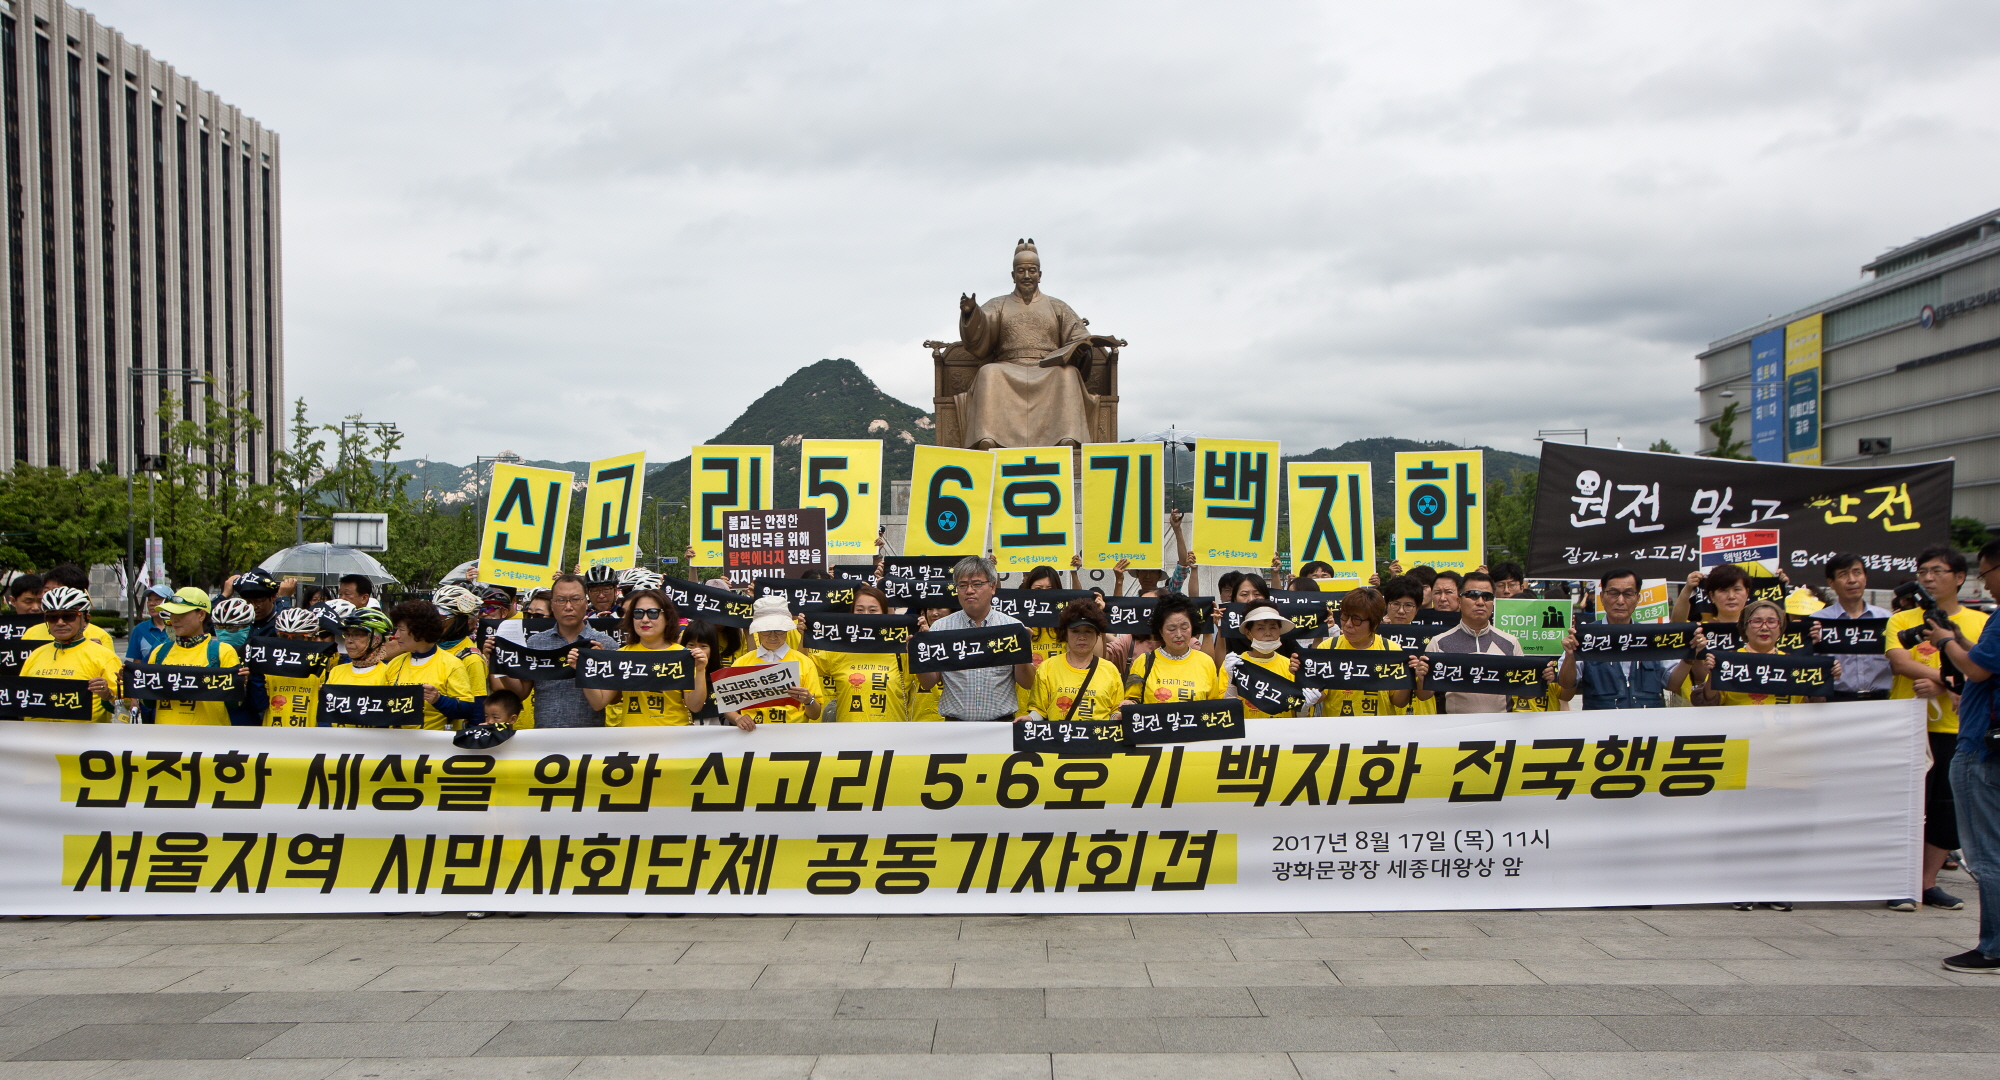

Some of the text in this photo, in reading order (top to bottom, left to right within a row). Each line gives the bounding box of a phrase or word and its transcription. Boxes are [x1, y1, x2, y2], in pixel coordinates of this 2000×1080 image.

[701, 456, 764, 542] 리
[925, 464, 974, 546] 6
[1000, 456, 1067, 548] 호
[1090, 454, 1152, 544] 기
[1204, 450, 1268, 542] 백
[1404, 460, 1477, 552] 화
[1571, 469, 1921, 536] 원전 말고 안전
[585, 463, 635, 552] 고
[493, 477, 562, 567] 신
[729, 514, 798, 531] 불교는 안전한
[1298, 474, 1364, 562] 지
[729, 531, 810, 549] 대한민국을 위해
[1712, 533, 1747, 550] 잘가라
[729, 549, 821, 566] 탈핵에너지 전환을
[1723, 549, 1761, 562] 핵발전소
[919, 566, 945, 582] 말고
[794, 589, 823, 606] 말고
[827, 588, 855, 605] 안전
[884, 580, 912, 598] 원전
[915, 581, 943, 599] 말고
[1637, 590, 1653, 603] OP!
[1754, 585, 1783, 601] 안전
[694, 594, 721, 612] 말고
[725, 601, 753, 619] 안전
[1024, 600, 1052, 617] 말고
[1110, 606, 1139, 624] 원전
[1636, 606, 1665, 620] 5,6호기
[1291, 614, 1318, 630] 안전
[1500, 615, 1537, 626] STOP!
[0, 624, 26, 640] 말고
[812, 621, 909, 643] 원전 말고 안전
[1532, 630, 1564, 641] 5,6호기
[1581, 632, 1686, 652] 원전 말고 안전
[1706, 632, 1735, 650] 원전
[1845, 628, 1877, 645] 말고
[0, 650, 17, 667] 전
[273, 649, 302, 666] 말고
[918, 635, 1022, 662] 원전 말고 안전
[525, 655, 555, 670] 말고
[585, 657, 614, 678] 원전
[619, 661, 648, 679] 말고
[652, 661, 685, 679] 안전
[1304, 658, 1408, 680] 원전 말고 안전
[133, 669, 235, 691] 원전 말고 안전
[871, 673, 889, 691] 탈
[1432, 662, 1538, 685] 원전 말고 안전
[1720, 661, 1824, 685] 원전 말고 안전
[16, 689, 82, 709] 말고 안전
[1254, 680, 1282, 704] 말고
[292, 695, 310, 713] 탈
[326, 692, 415, 715] 원전 말고 안전
[647, 695, 665, 714] 핵
[869, 693, 887, 713] 핵
[1077, 699, 1096, 717] 탈
[1361, 699, 1378, 716] 핵
[1131, 710, 1235, 733] 원전 말고 안전
[1024, 721, 1124, 743] 원전 말고 안전
[75, 750, 272, 810] 안전한
[298, 753, 498, 813] 세상을
[527, 751, 662, 813] 위한
[690, 749, 894, 813] 신고리
[1215, 740, 1421, 808] 백지화
[1448, 734, 1728, 802] 전국행동
[1271, 828, 1552, 854] 2017년 8월 17일 (목) 11시
[73, 829, 1219, 896] 서울지역 시민사회단체 공동기자회견
[1271, 857, 1524, 882] 광화문광장 세종대왕상 앞
